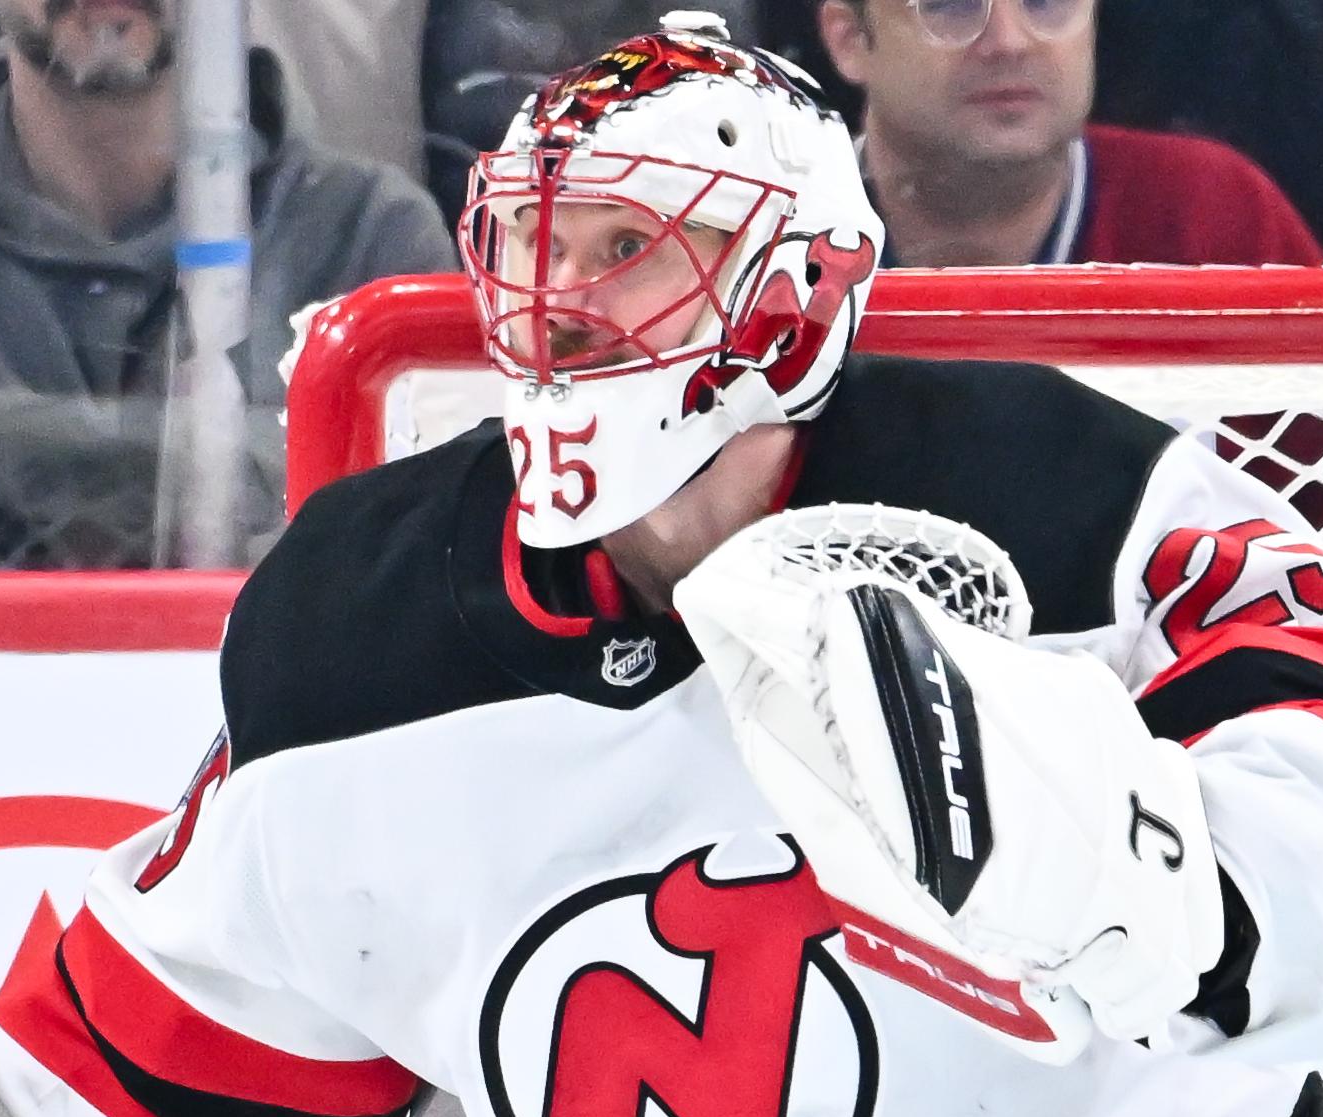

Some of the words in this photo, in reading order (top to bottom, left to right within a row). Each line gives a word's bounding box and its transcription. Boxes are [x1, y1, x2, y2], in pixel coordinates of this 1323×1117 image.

[506, 414, 599, 519] 25
[615, 648, 649, 678] NHL
[923, 648, 976, 863] TRUE
